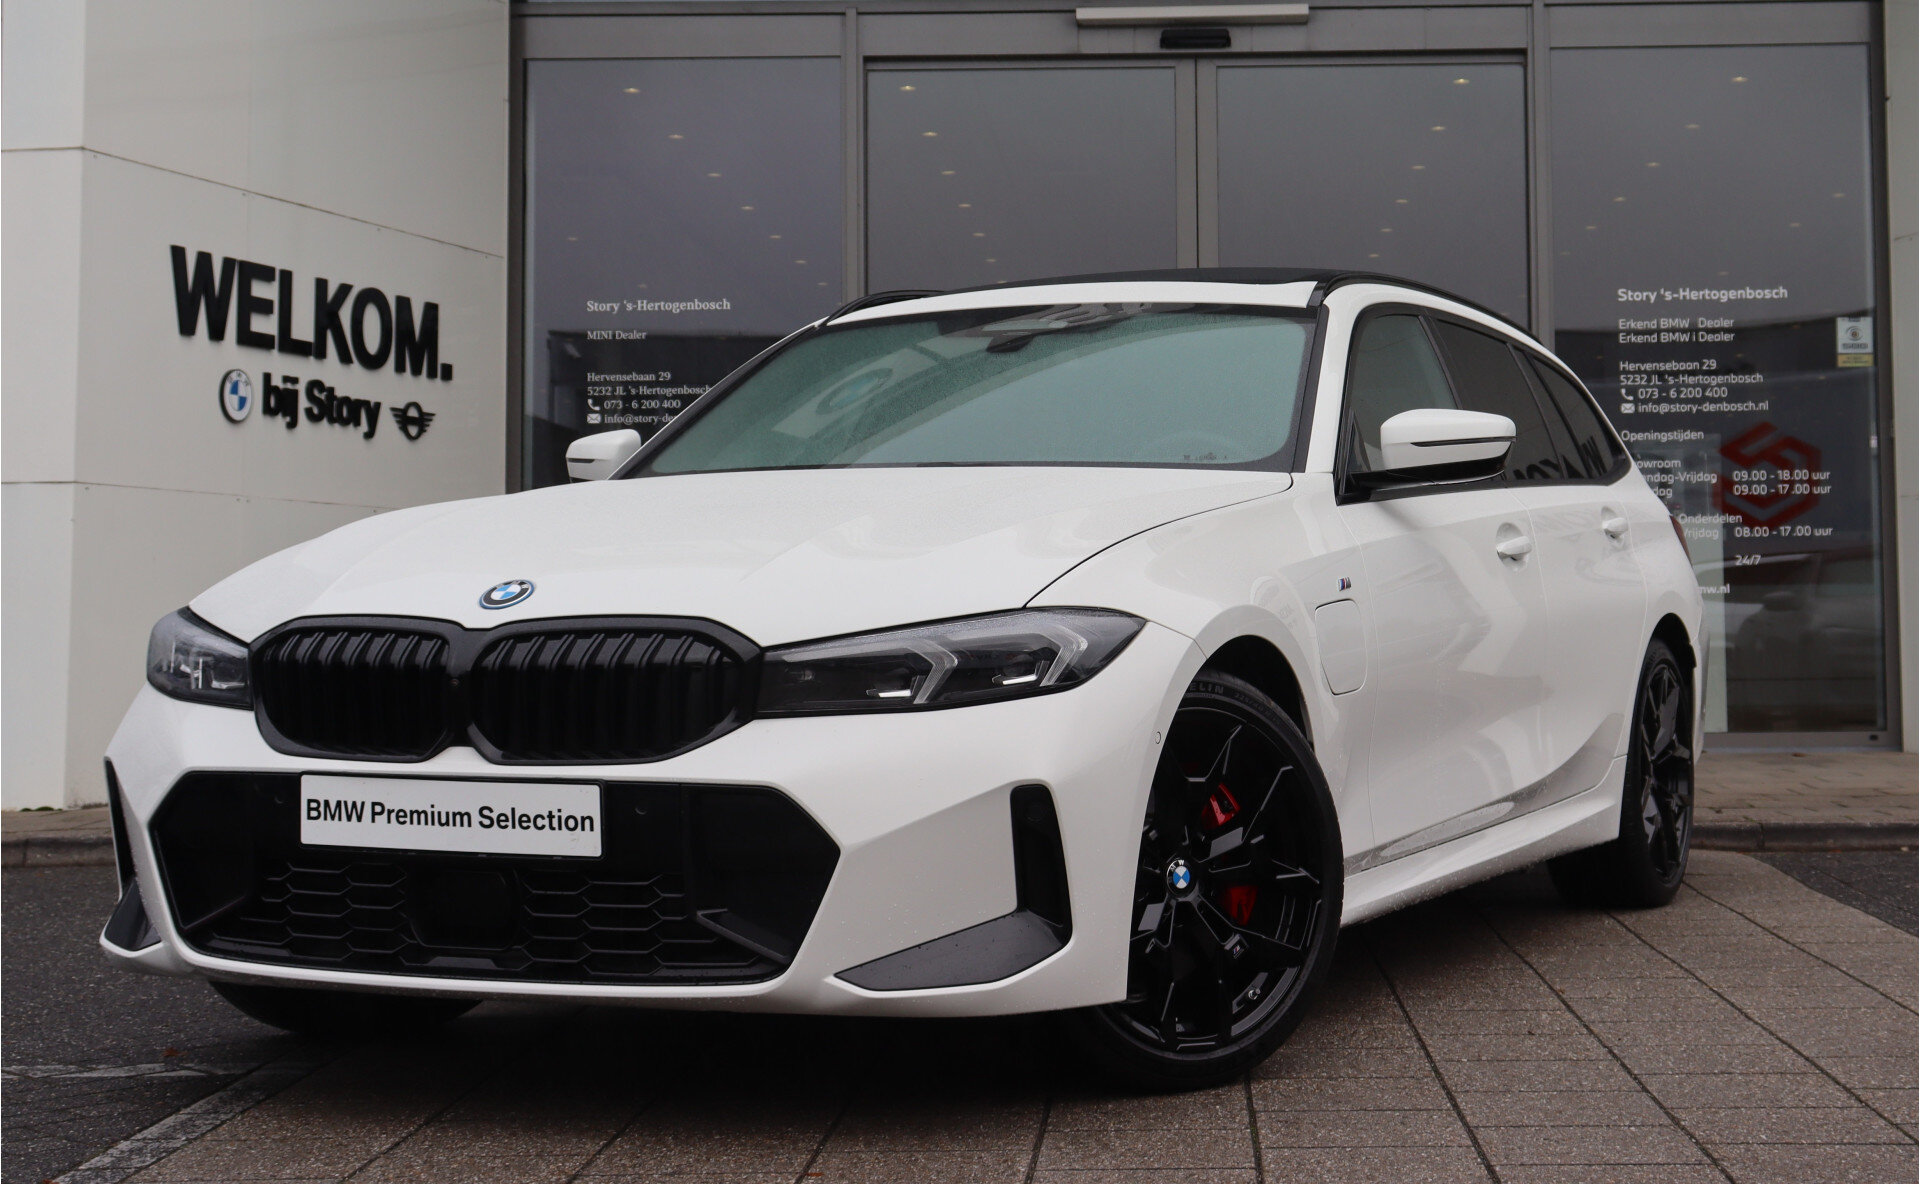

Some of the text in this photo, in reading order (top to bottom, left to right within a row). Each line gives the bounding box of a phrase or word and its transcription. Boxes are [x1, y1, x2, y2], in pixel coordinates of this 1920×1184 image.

[1617, 286, 1788, 303] Story 's-Hertogenbosch
[586, 298, 731, 314] Story 's-Hertogenbosch
[170, 244, 453, 382] WELKOM.
[1618, 317, 1735, 330] Erkend BMW Dealer
[587, 330, 647, 340] MINI Dealer
[1618, 332, 1657, 343] Erkend
[1660, 332, 1690, 342] BMW
[1699, 331, 1735, 342] Dealer
[1619, 359, 1717, 371] Hervensebaan 29
[587, 371, 671, 382] Hervensebaan 29
[1620, 373, 1764, 386] 5232 JL 's-Hertogenbosch
[587, 386, 613, 396] 5232
[614, 386, 626, 396] JL
[1638, 388, 1659, 399] 073
[1670, 387, 1677, 398] 6
[1680, 387, 1703, 398] 200
[1705, 386, 1728, 398] 400
[262, 372, 381, 440] bij Story
[604, 400, 622, 409] 073
[631, 399, 638, 409] 6
[640, 399, 660, 409] 200
[662, 399, 681, 409] 400
[1638, 400, 1769, 414] info@story-denbosch.nl
[1621, 430, 1705, 443] Openingstijden
[1733, 470, 1767, 481] 09.00
[1778, 469, 1809, 481] 18.00
[1812, 471, 1831, 481] uur
[1733, 484, 1768, 495] 09.00
[1813, 485, 1832, 495] uur
[1678, 513, 1743, 525] Onderdelen
[1734, 526, 1770, 537] 08.00
[1814, 527, 1833, 537] uur
[1735, 554, 1762, 566] 24/7
[1190, 682, 1224, 694] ELIN
[306, 798, 595, 832] BMW Premium Selection
